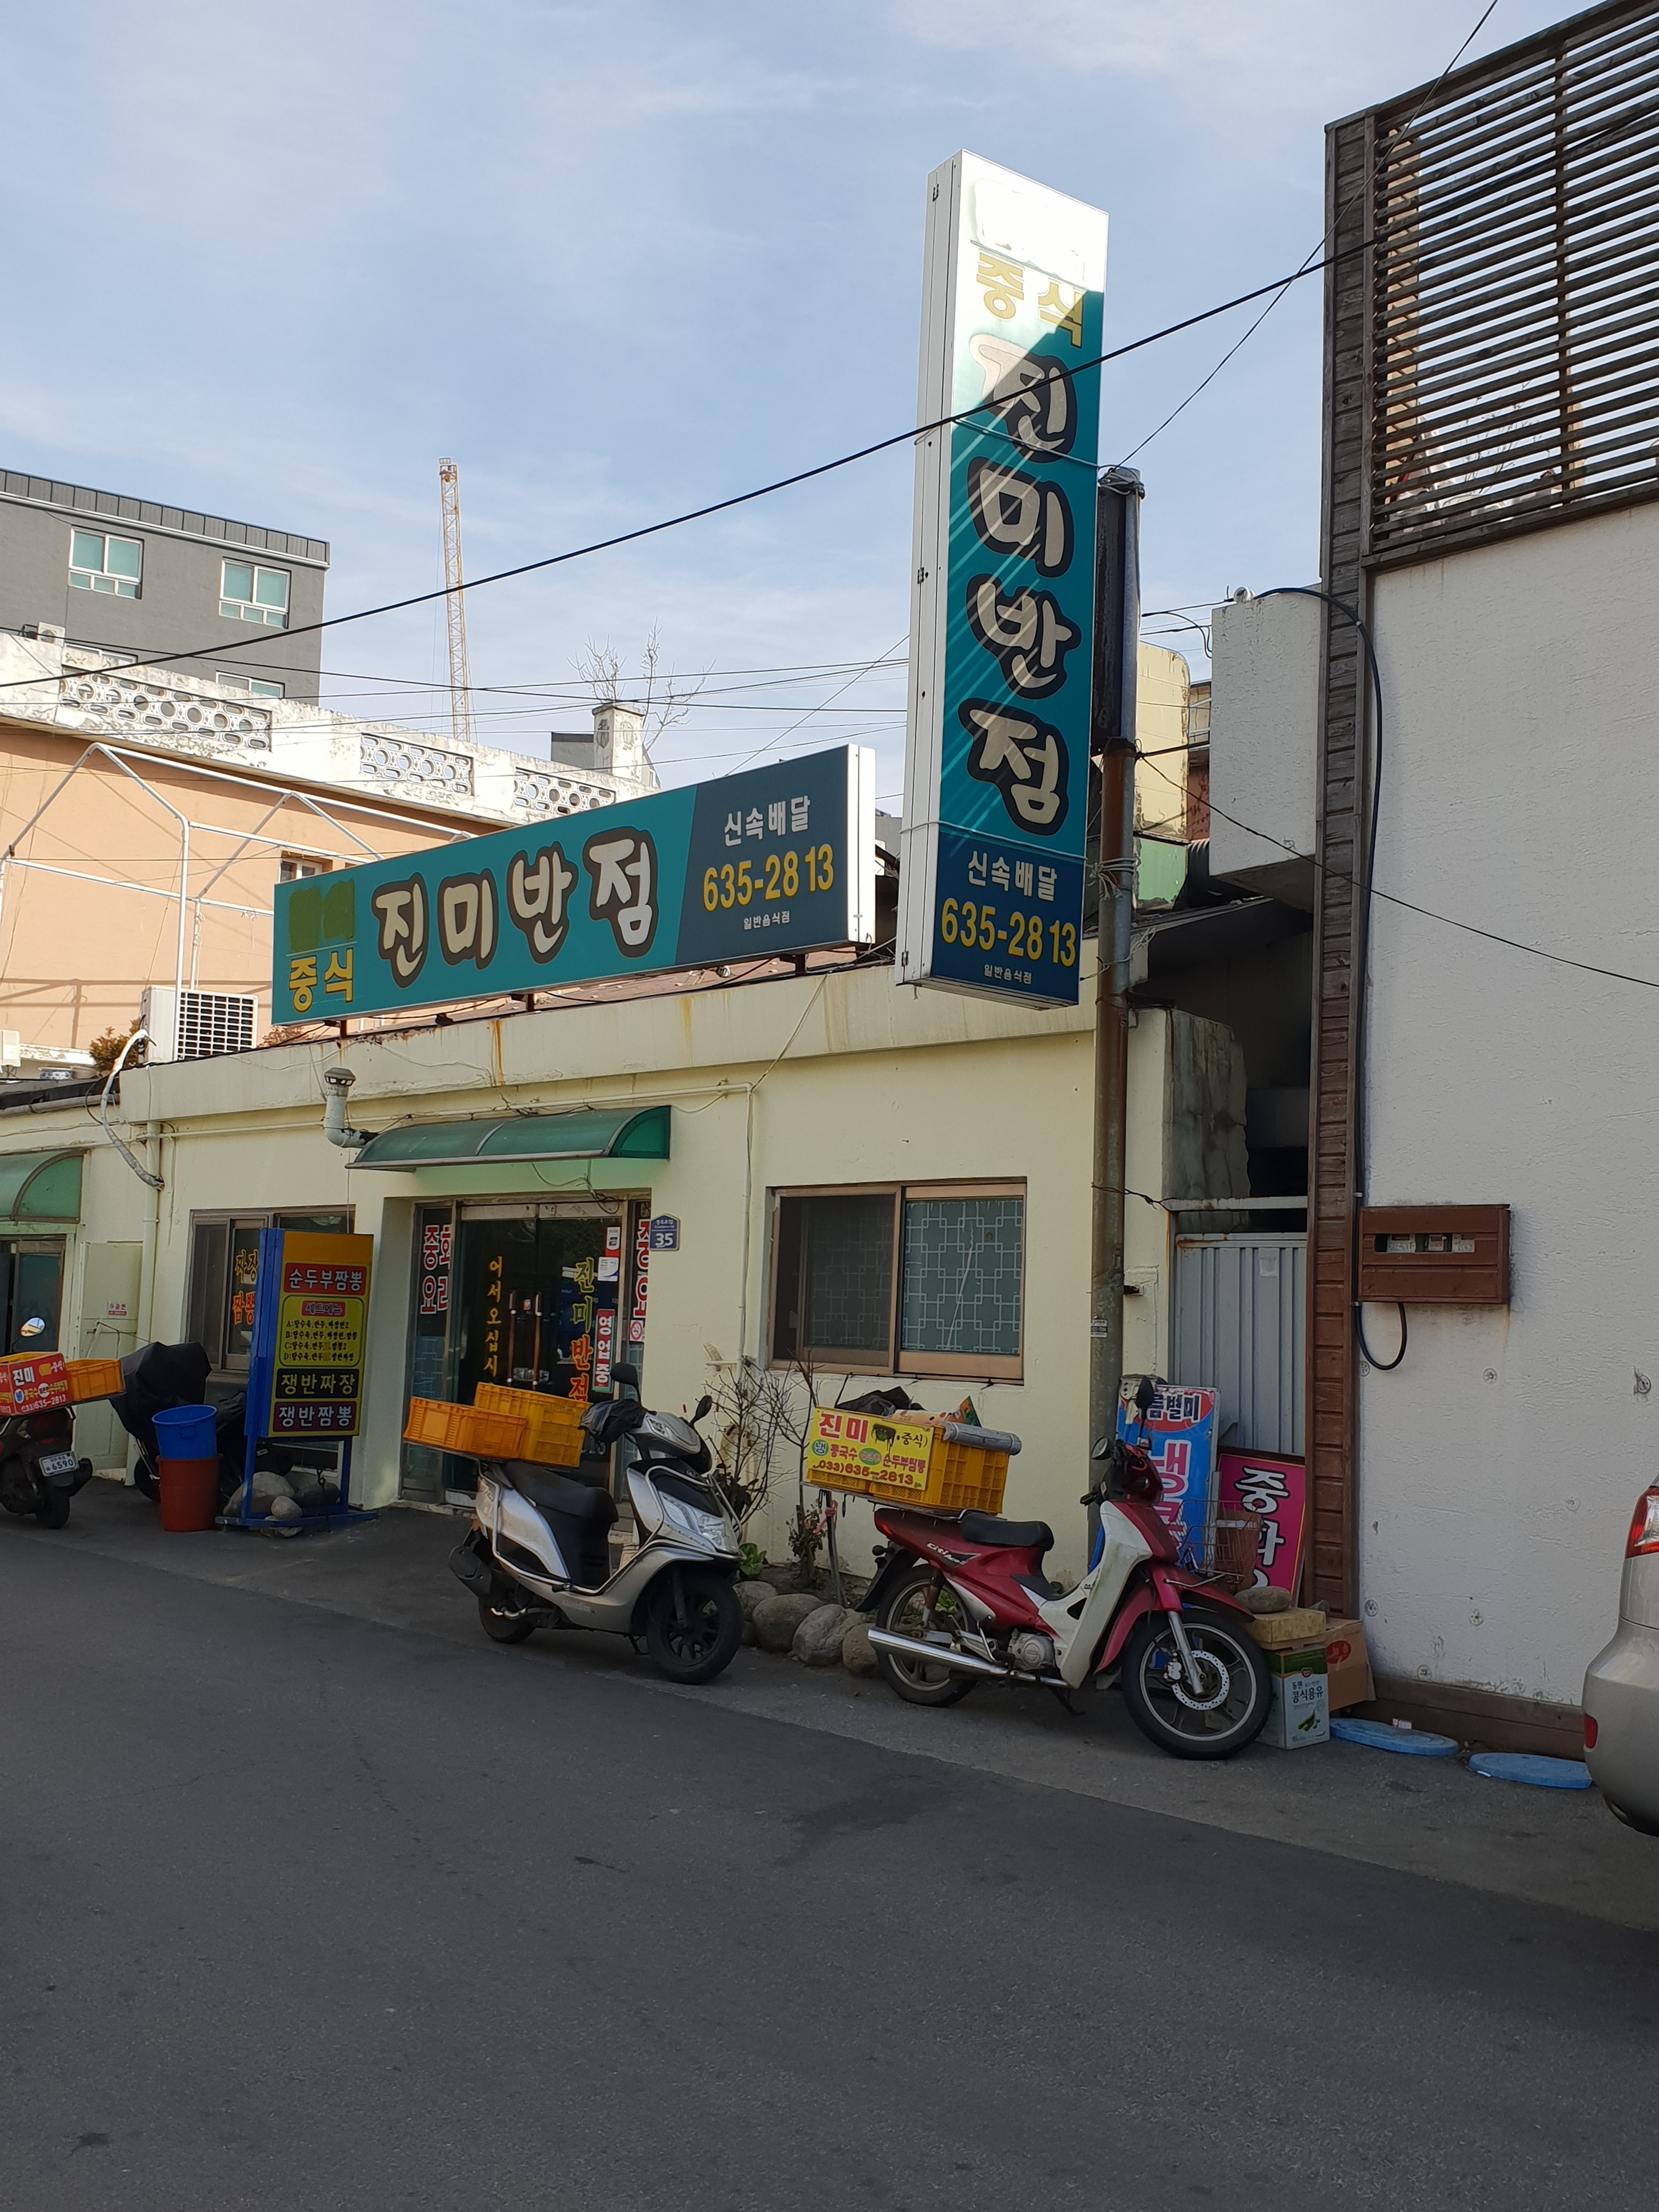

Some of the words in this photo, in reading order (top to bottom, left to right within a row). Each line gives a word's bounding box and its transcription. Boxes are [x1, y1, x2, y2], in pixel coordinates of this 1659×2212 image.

[976, 250, 1084, 349] 중식
[958, 333, 1081, 836] 진미반점
[724, 795, 811, 848] 신속배달
[703, 844, 834, 912] 635-2813
[968, 850, 1058, 902] 신속배달
[372, 827, 658, 988] 진미반점
[743, 910, 789, 930] 일반음식점
[941, 898, 1076, 967] 635-2813
[287, 949, 356, 1013] 중식
[984, 964, 1031, 984] 일반음식점
[655, 1233, 674, 1248] 35
[235, 1249, 259, 1284] 짜장
[289, 1268, 363, 1291] 순두부짬뽕
[233, 1290, 256, 1325] 짬뽕
[306, 1302, 343, 1315] 세트메뉴
[483, 1256, 503, 1383] 어서오십시
[569, 1257, 594, 1402] 진미반점
[596, 1316, 612, 1384] 영업중
[13, 1367, 35, 1386] 진미
[281, 1374, 356, 1395] 쟁반짜장
[279, 1406, 352, 1426] 쟁반짬뽕
[1148, 1392, 1201, 1422] 름별미
[819, 1413, 869, 1443] 진미
[52, 1459, 74, 1470] 6590
[815, 1441, 826, 1454] 냉
